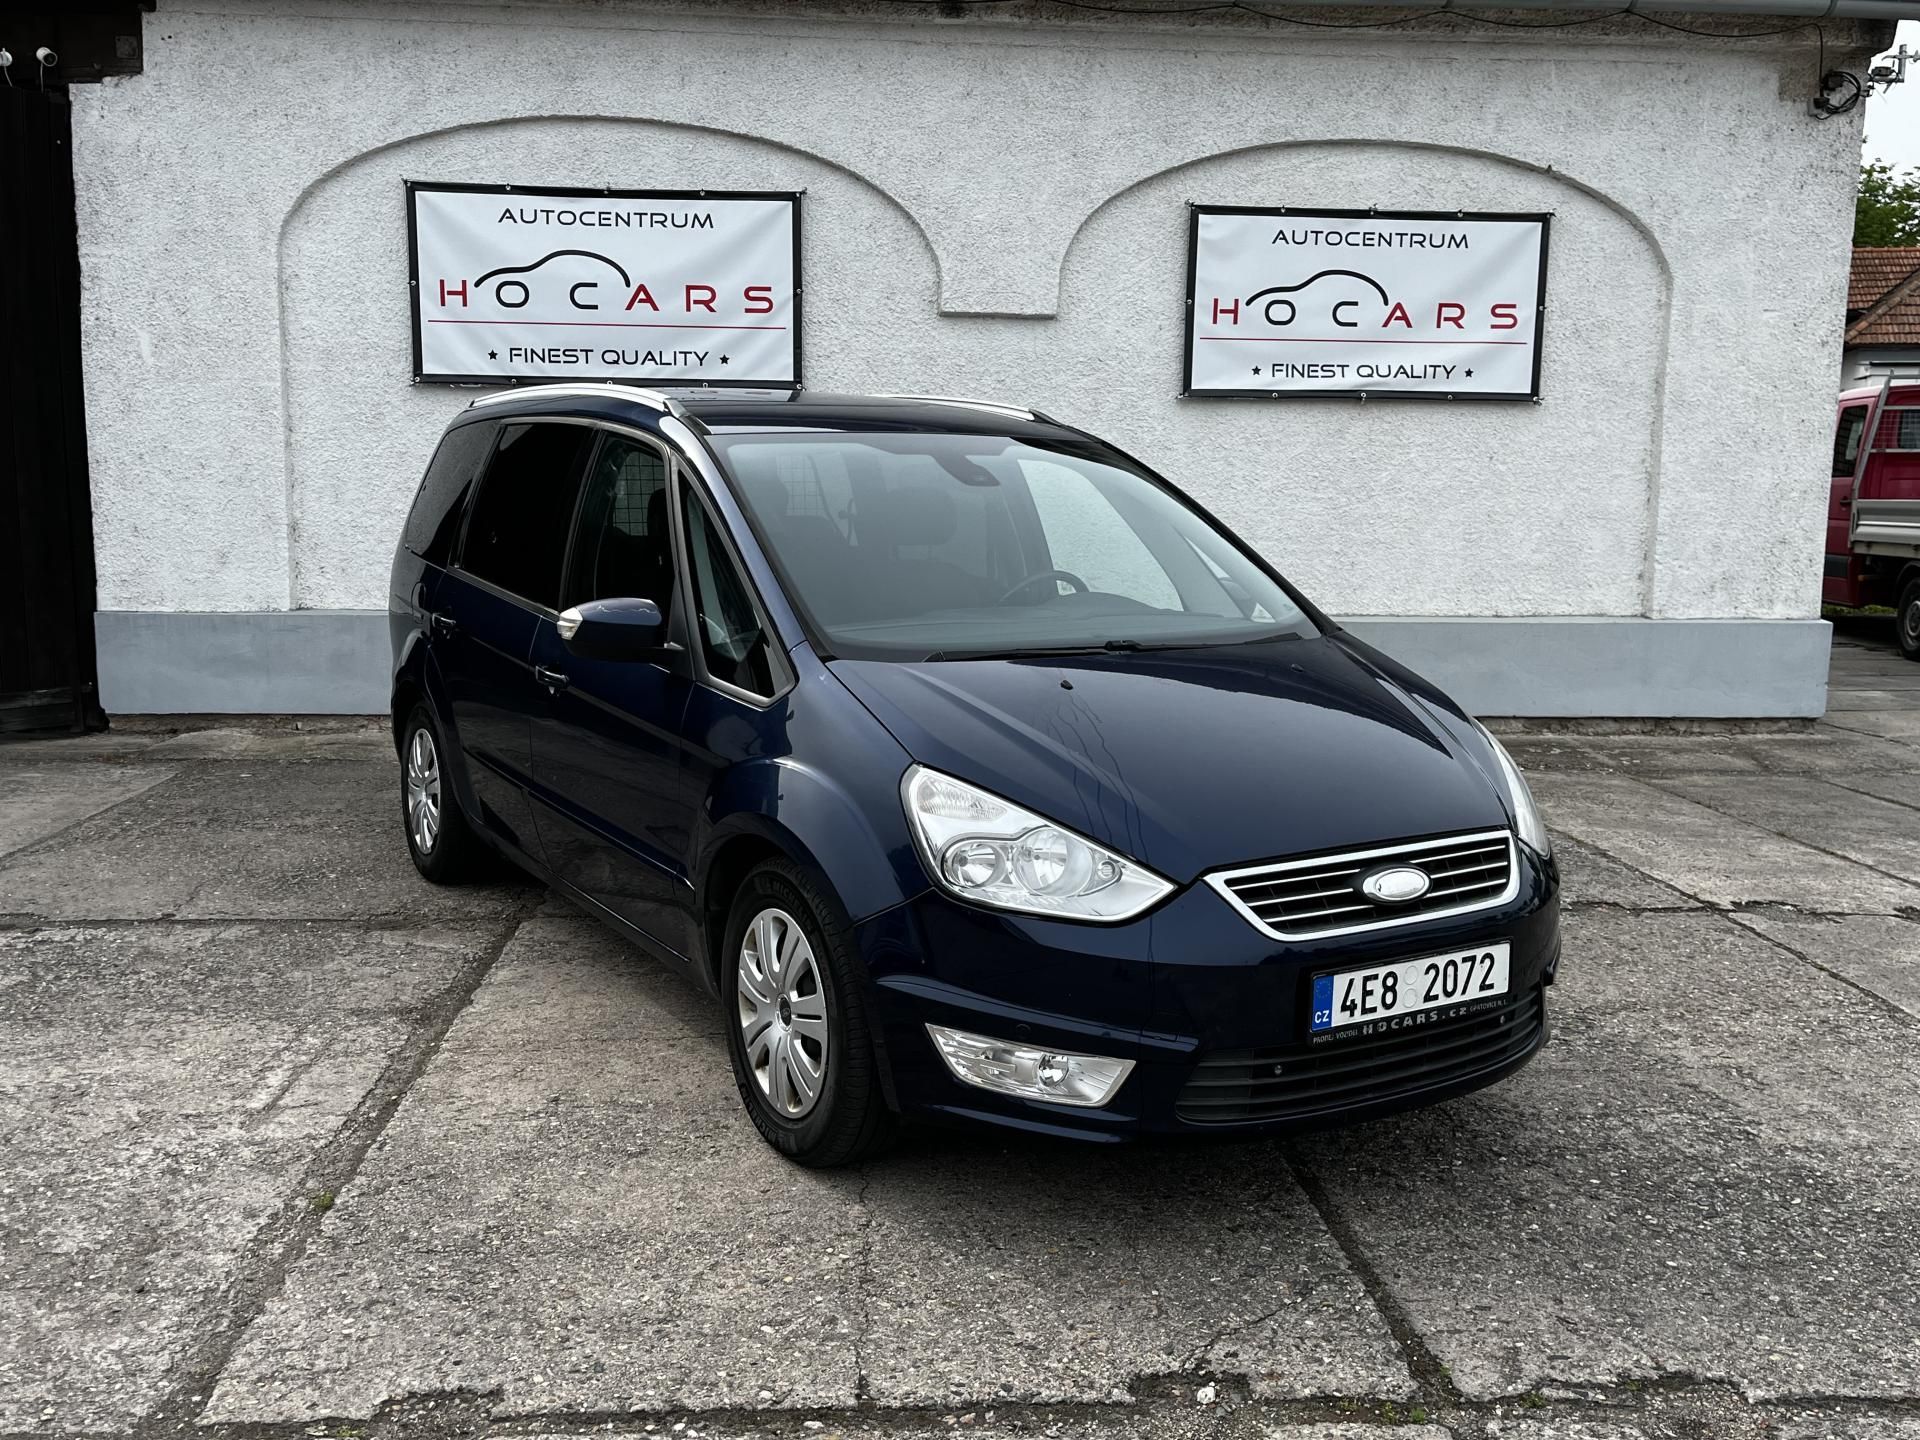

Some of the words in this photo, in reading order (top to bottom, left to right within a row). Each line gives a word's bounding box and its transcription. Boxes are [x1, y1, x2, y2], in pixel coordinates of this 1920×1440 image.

[498, 207, 714, 229] AUTOCENTRUM
[1272, 229, 1469, 249] AUTOCENTRUM
[439, 279, 774, 314] HOCARS
[1212, 298, 1518, 329] HOCARS
[509, 347, 594, 365] FINEST
[601, 349, 710, 367] QUALITY
[1271, 363, 1350, 379] FINEST
[1356, 364, 1457, 380] QUALITY
[1340, 971, 1398, 1018] 4E8
[1423, 952, 1495, 1003] 2072
[1314, 1010, 1330, 1024] CZ
